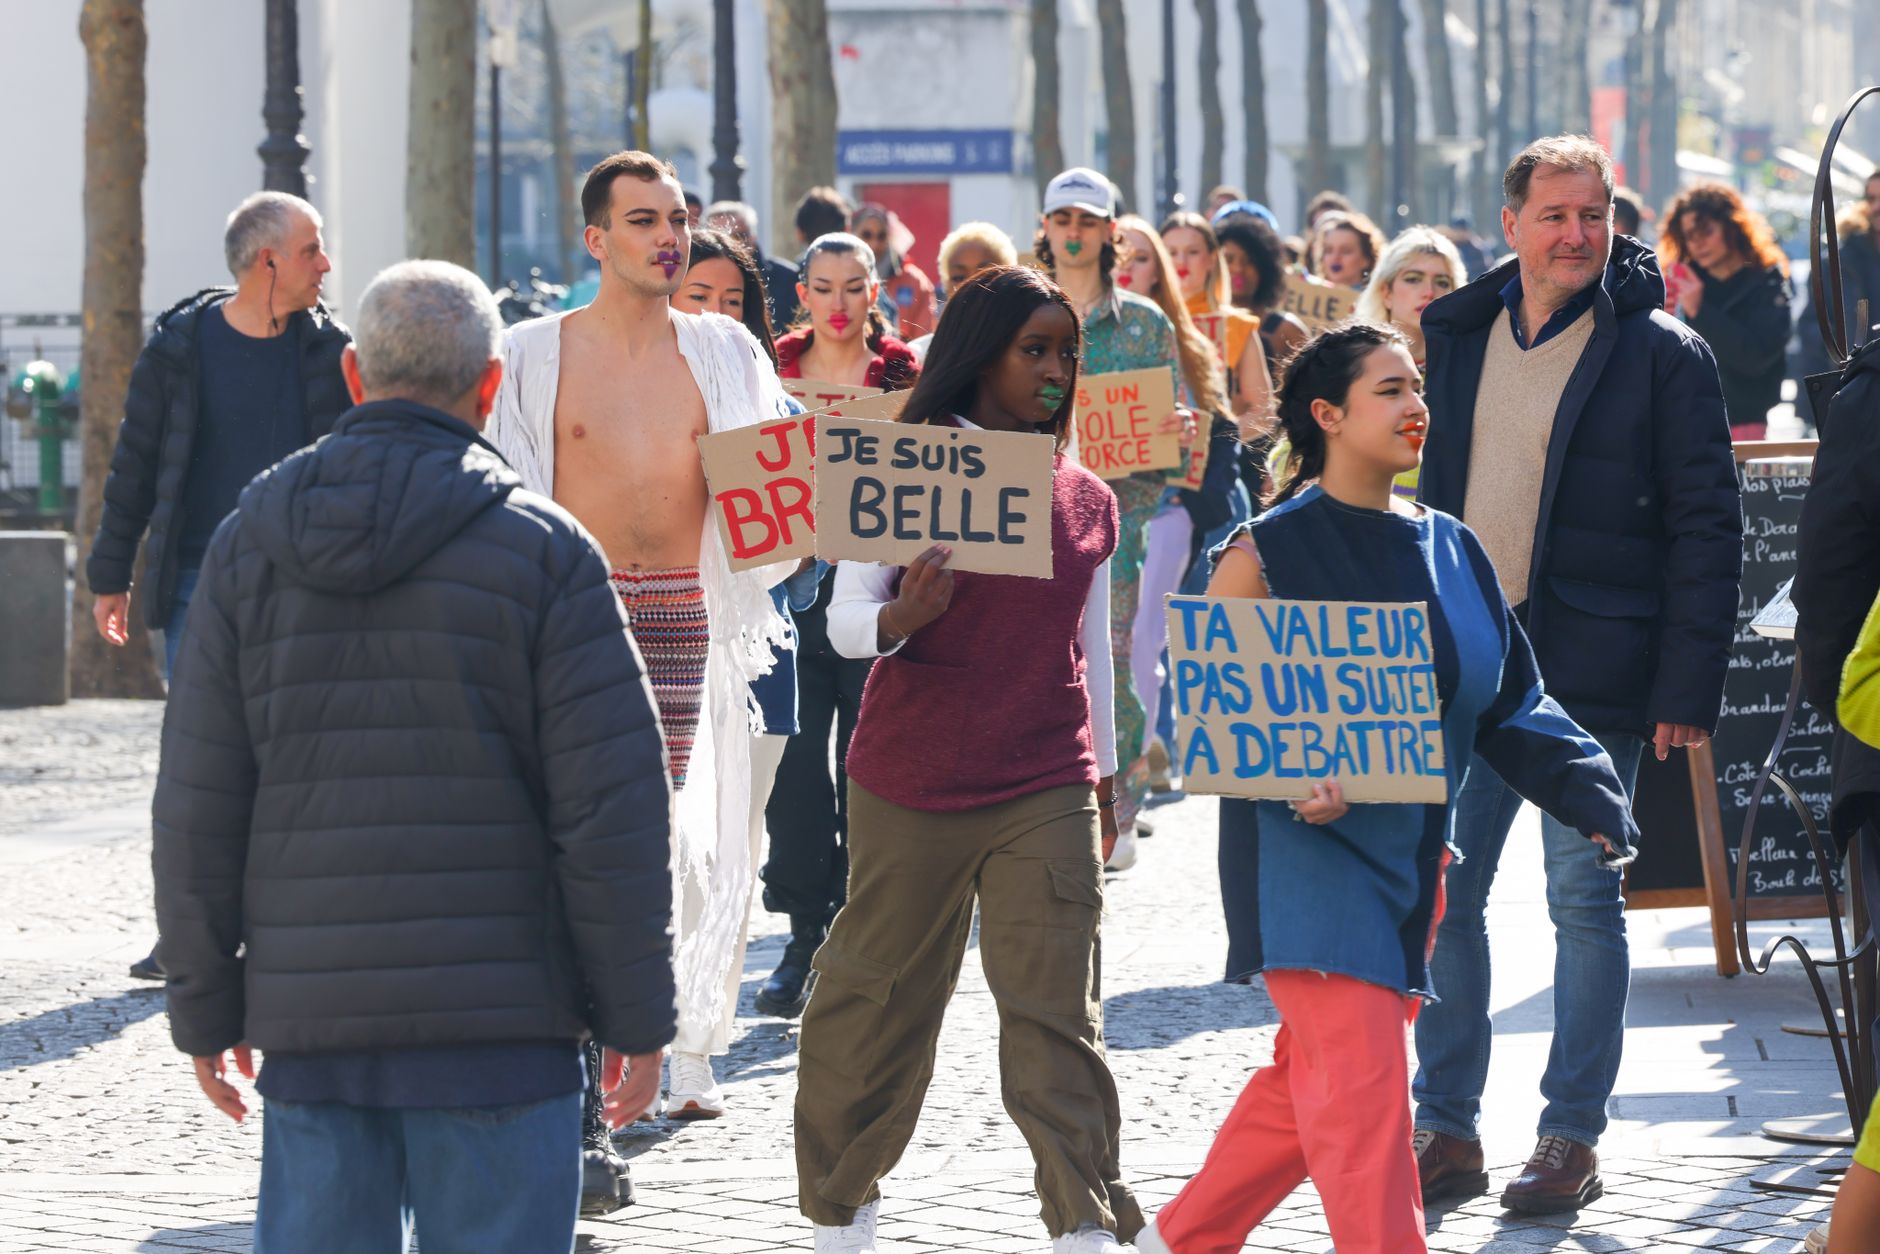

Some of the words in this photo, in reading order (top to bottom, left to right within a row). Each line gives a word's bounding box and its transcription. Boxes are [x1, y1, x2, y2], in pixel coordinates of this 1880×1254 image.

[1105, 383, 1139, 404] UN
[826, 428, 880, 466] JE
[1077, 404, 1152, 443] OLE
[1079, 439, 1151, 470] ORCE
[849, 476, 1031, 544] BELLE
[1169, 600, 1238, 653] TA
[1254, 604, 1430, 662] VALEUR
[1176, 659, 1253, 715] PAS
[1260, 662, 1330, 717] UN
[1336, 662, 1436, 715] SUJET
[1183, 714, 1220, 776] À
[1229, 720, 1447, 779] DEBATTRE
